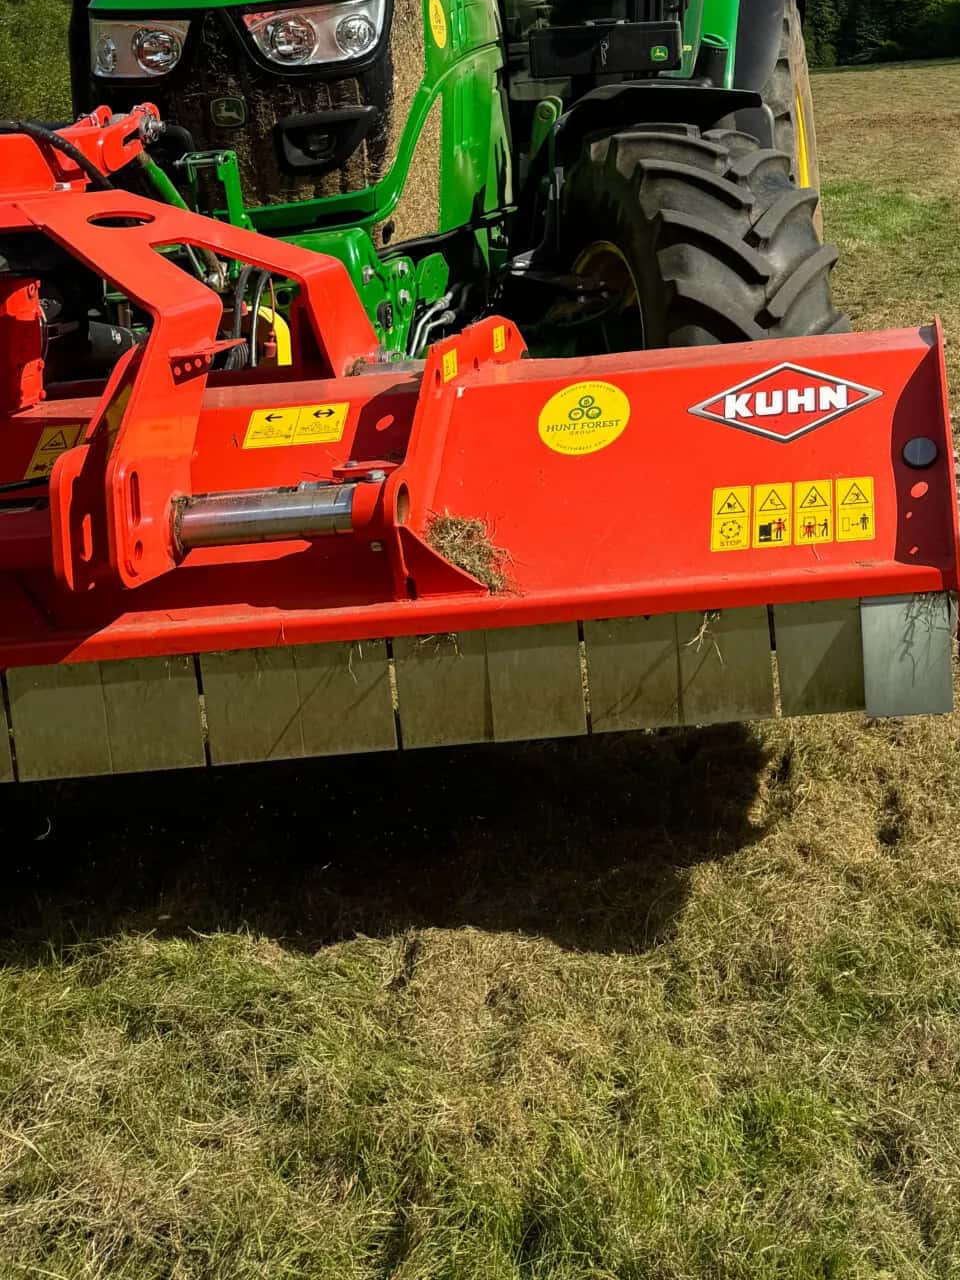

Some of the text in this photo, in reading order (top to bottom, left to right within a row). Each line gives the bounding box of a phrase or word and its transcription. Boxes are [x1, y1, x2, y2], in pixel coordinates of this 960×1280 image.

[724, 384, 848, 419] KUHN
[546, 419, 621, 432] HUNT FOREST
[720, 539, 742, 547] STOP
